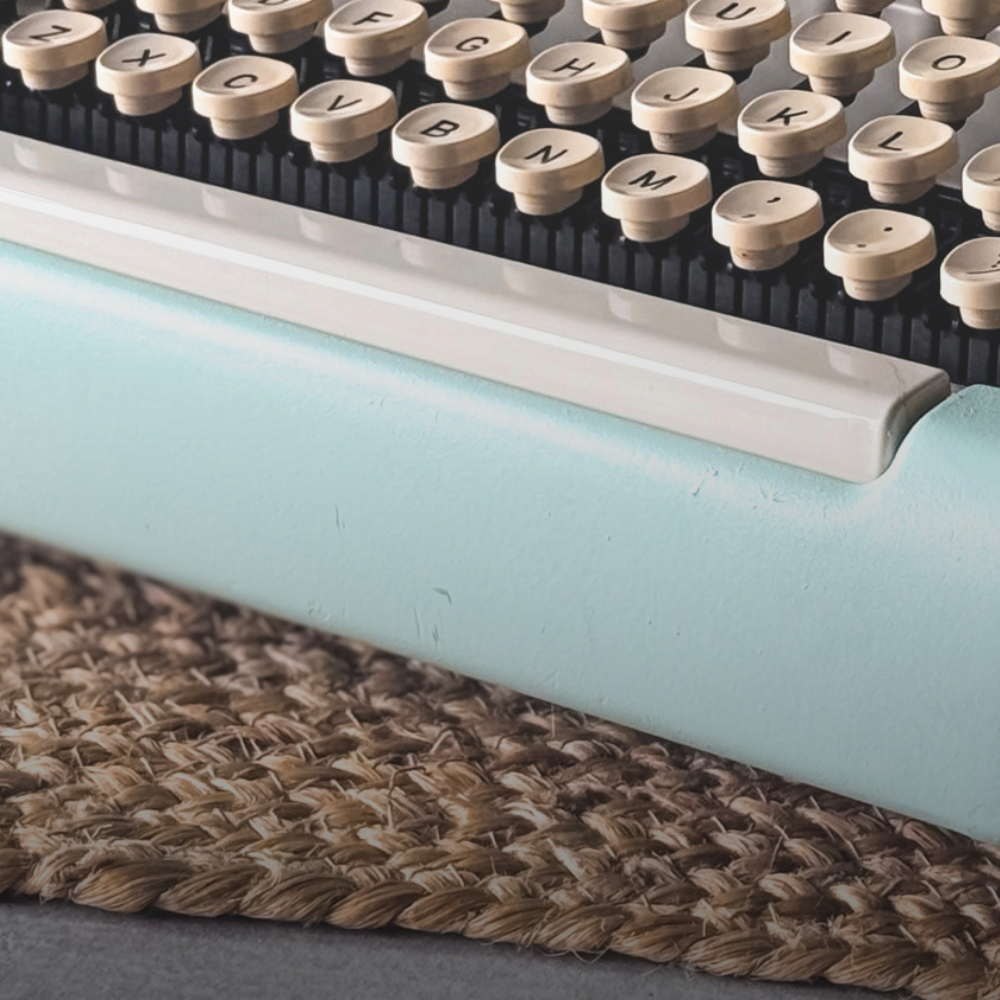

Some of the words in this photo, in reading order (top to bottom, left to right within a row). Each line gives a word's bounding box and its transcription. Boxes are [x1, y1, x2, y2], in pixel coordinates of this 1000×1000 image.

[353, 11, 394, 27] F
[716, 2, 757, 21] U
[31, 25, 72, 42] Z
[825, 30, 852, 46] I
[455, 36, 490, 52] G
[122, 49, 166, 67] X
[931, 55, 967, 71] O
[552, 58, 596, 78] H
[224, 73, 258, 89] C
[664, 87, 700, 102] J
[326, 95, 362, 112] V
[766, 106, 808, 126] K
[420, 120, 460, 138] B
[878, 131, 904, 152] L
[524, 145, 568, 164] N
[628, 169, 678, 191] M
